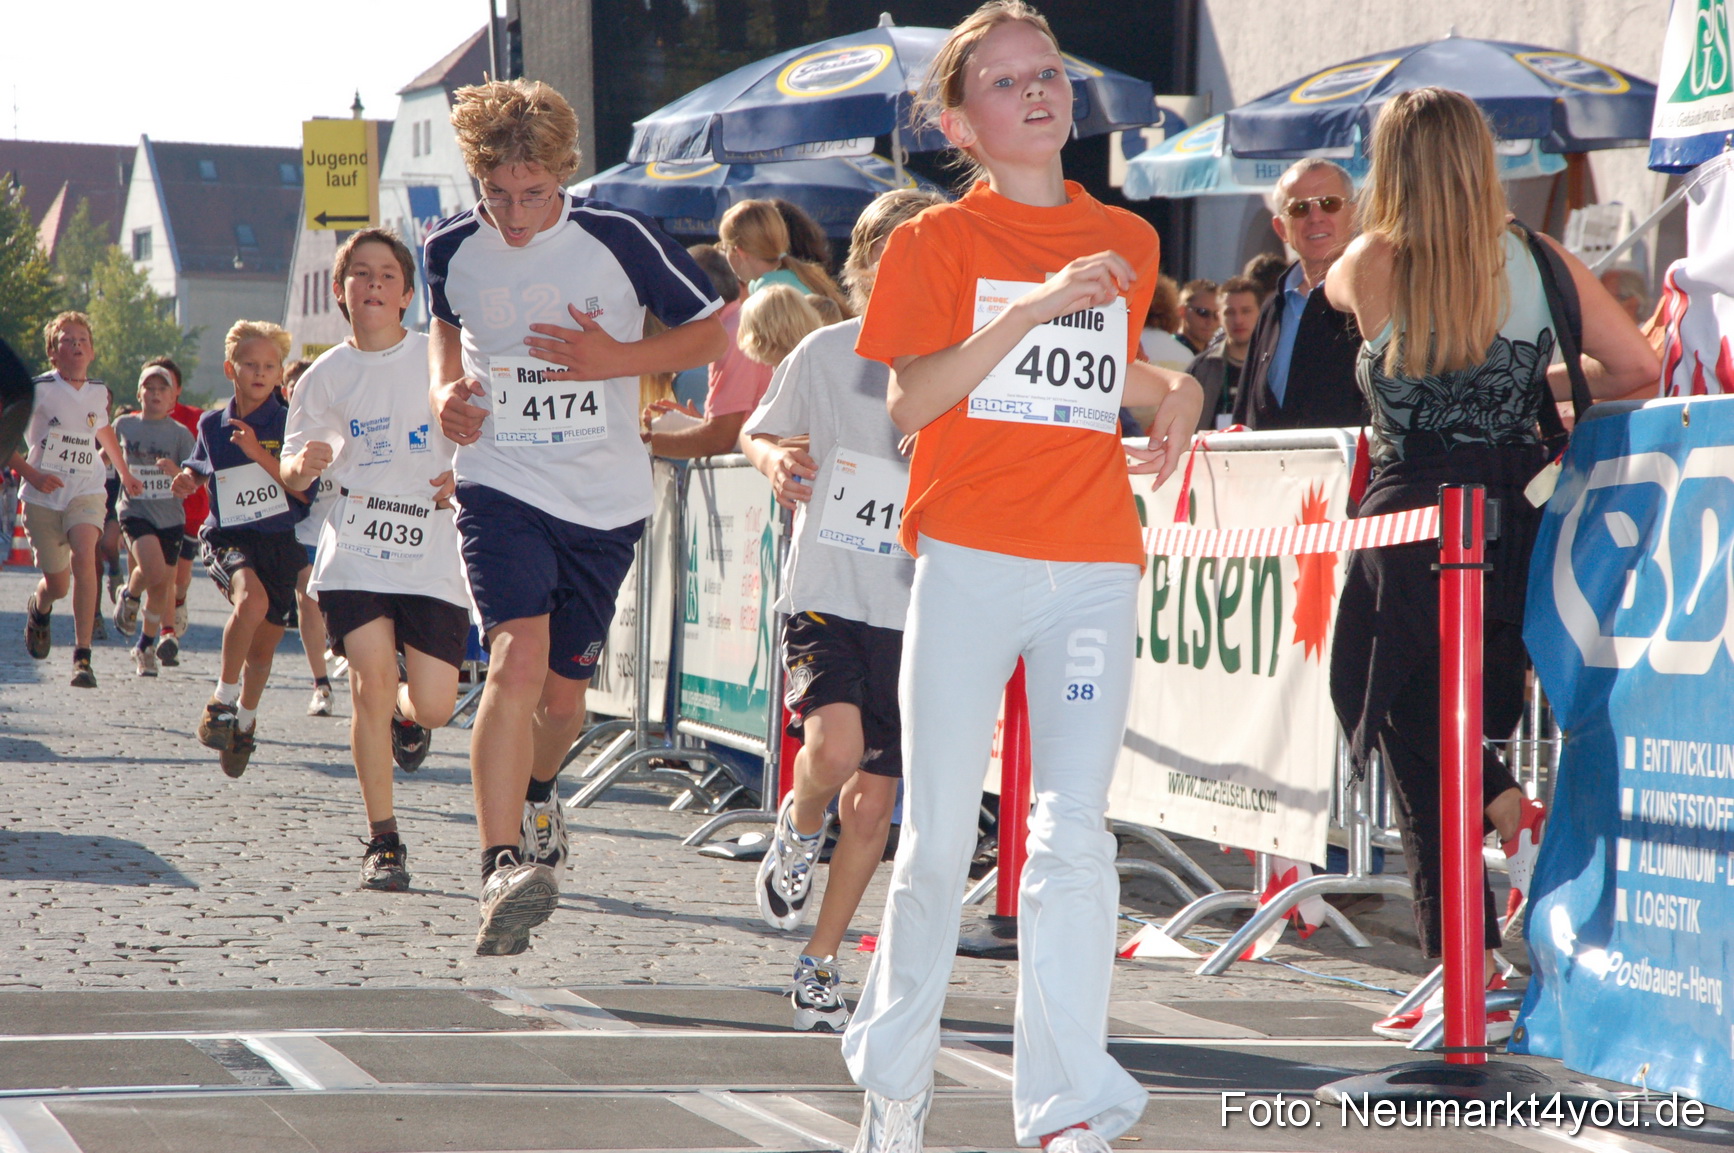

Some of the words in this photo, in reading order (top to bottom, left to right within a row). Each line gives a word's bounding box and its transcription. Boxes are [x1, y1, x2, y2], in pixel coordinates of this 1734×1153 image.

[306, 150, 368, 169] Jugend
[326, 170, 358, 187] lauf
[1015, 345, 1116, 394] 4030
[498, 391, 507, 404] J
[522, 390, 598, 421] 4174
[970, 397, 1032, 414] BOCK
[1073, 406, 1117, 425] PFLEIDERER
[62, 435, 90, 446] Michael
[496, 432, 537, 442] BOCK
[564, 426, 606, 438] PFLEIDERER
[59, 449, 93, 465] 4180
[142, 480, 171, 490] 4185
[235, 484, 278, 507] 4260
[834, 487, 845, 501] J
[366, 496, 430, 518] Alexander
[347, 514, 355, 524] J
[363, 520, 424, 547] 4039
[820, 529, 865, 546] BOCK
[1065, 628, 1108, 678] S
[1066, 684, 1095, 701] 38
[1641, 788, 1734, 832] KUNSTSTOFF
[1638, 840, 1716, 884] ALUMINIUM
[1635, 889, 1701, 934] LOGISTIK
[1600, 951, 1723, 1016] Postbauer-Heng
